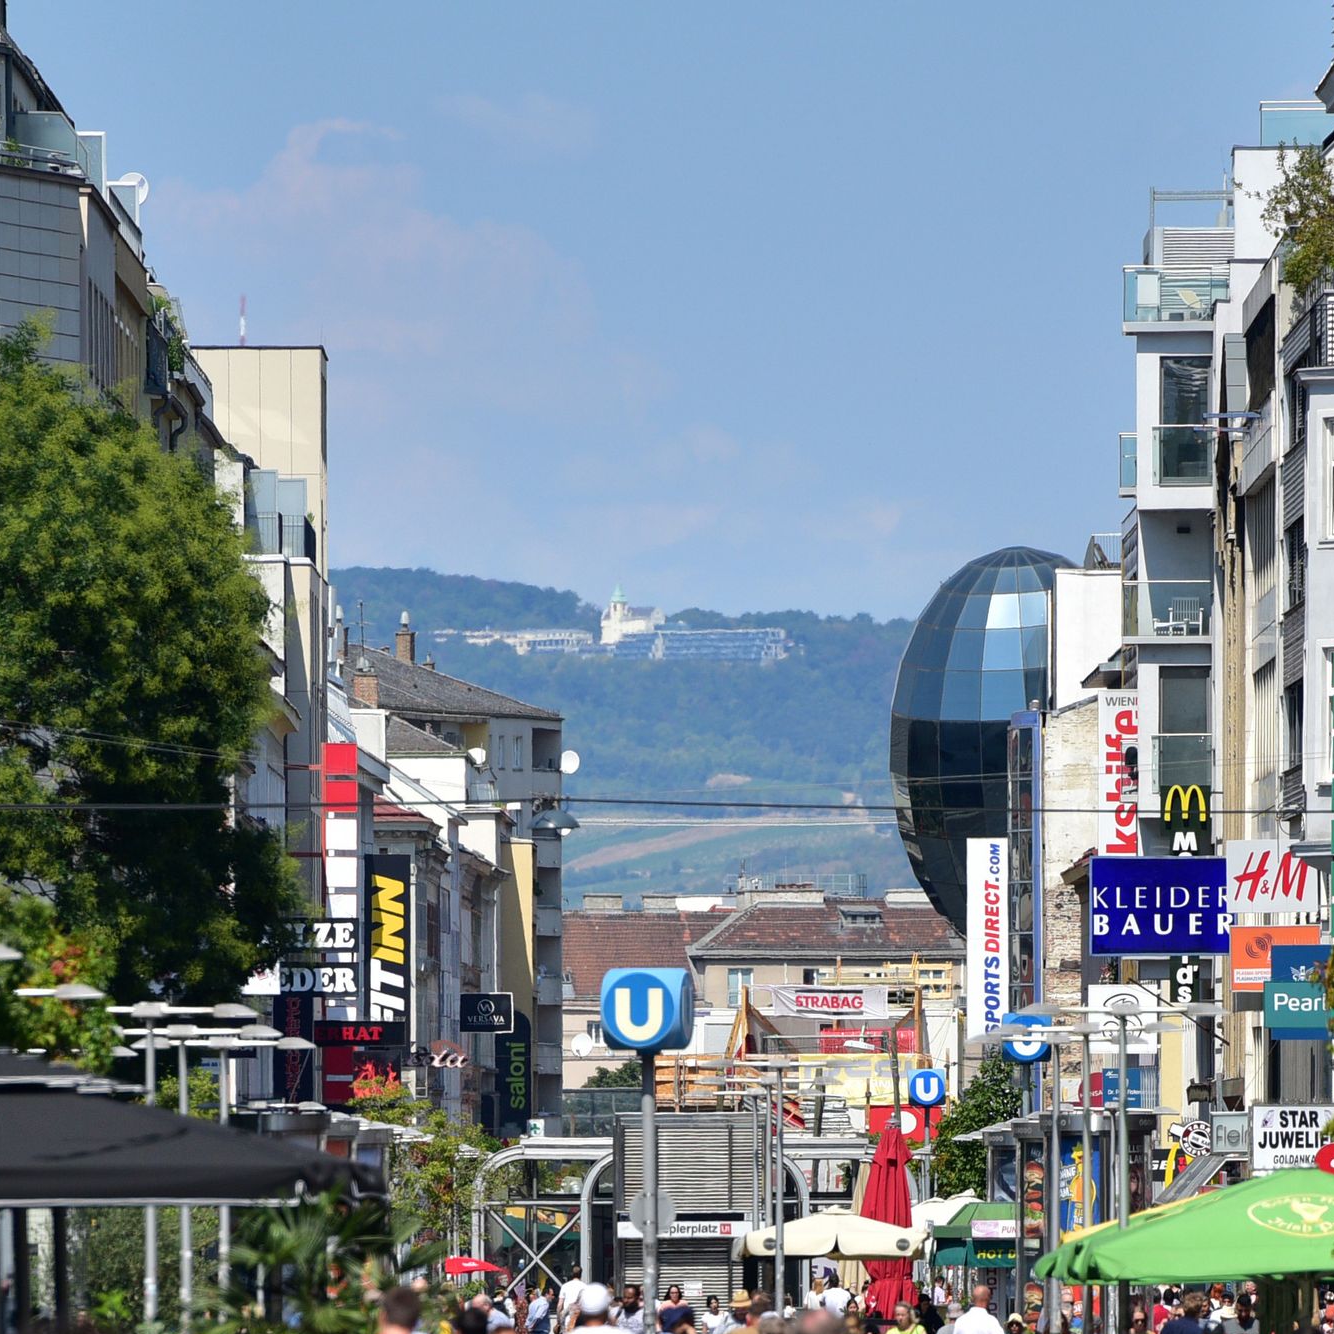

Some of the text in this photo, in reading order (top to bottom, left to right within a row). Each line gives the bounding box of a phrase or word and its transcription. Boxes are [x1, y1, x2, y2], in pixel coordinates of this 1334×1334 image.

[1233, 850, 1309, 902] H&M
[1093, 913, 1233, 936] BAUER
[795, 995, 863, 1010] STRABAG
[615, 988, 663, 1042] U
[915, 1078, 940, 1101] U
[1279, 1110, 1319, 1128] STAR
[1274, 1155, 1316, 1165] GOLDANKA
[667, 1223, 718, 1236] plerplatz
[977, 1249, 1003, 1259] HOT
[1008, 1249, 1017, 1259] D
